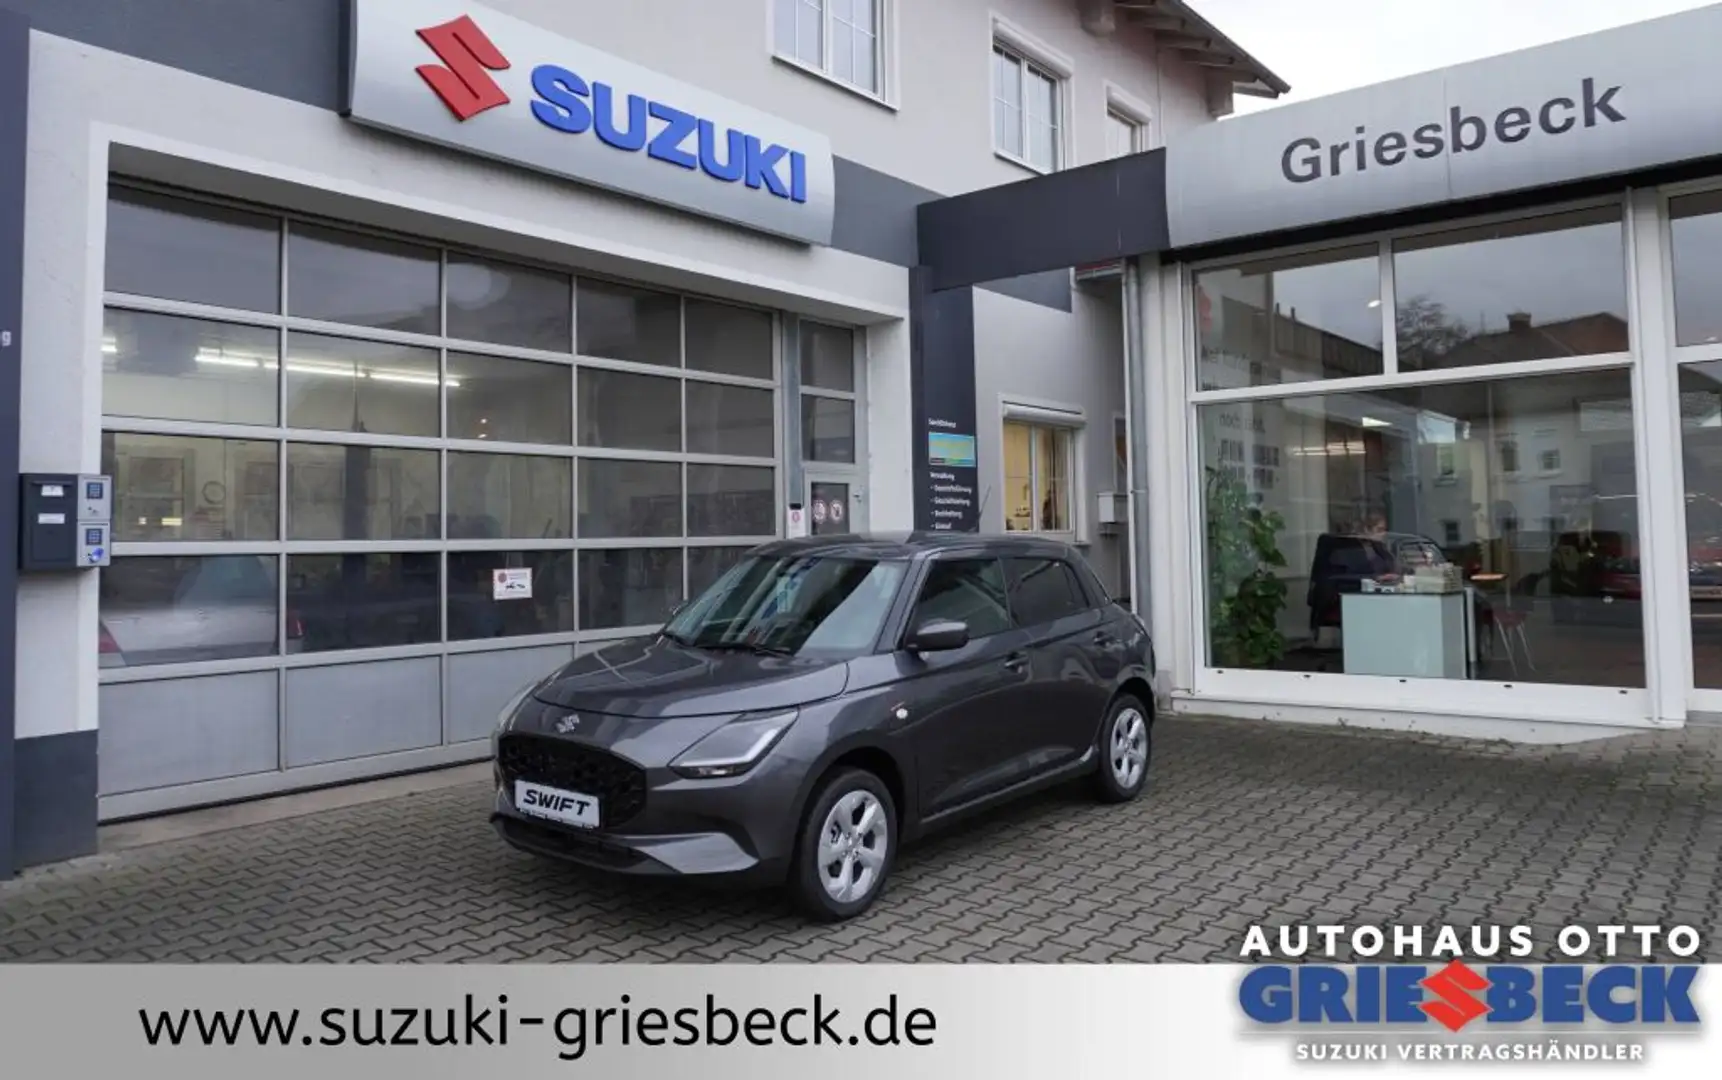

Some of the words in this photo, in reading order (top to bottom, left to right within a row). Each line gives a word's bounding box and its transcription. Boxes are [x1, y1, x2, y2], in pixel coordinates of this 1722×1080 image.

[530, 64, 807, 203] SUZUKI
[1281, 77, 1627, 183] Griesbeck
[523, 789, 591, 816] SWIFT
